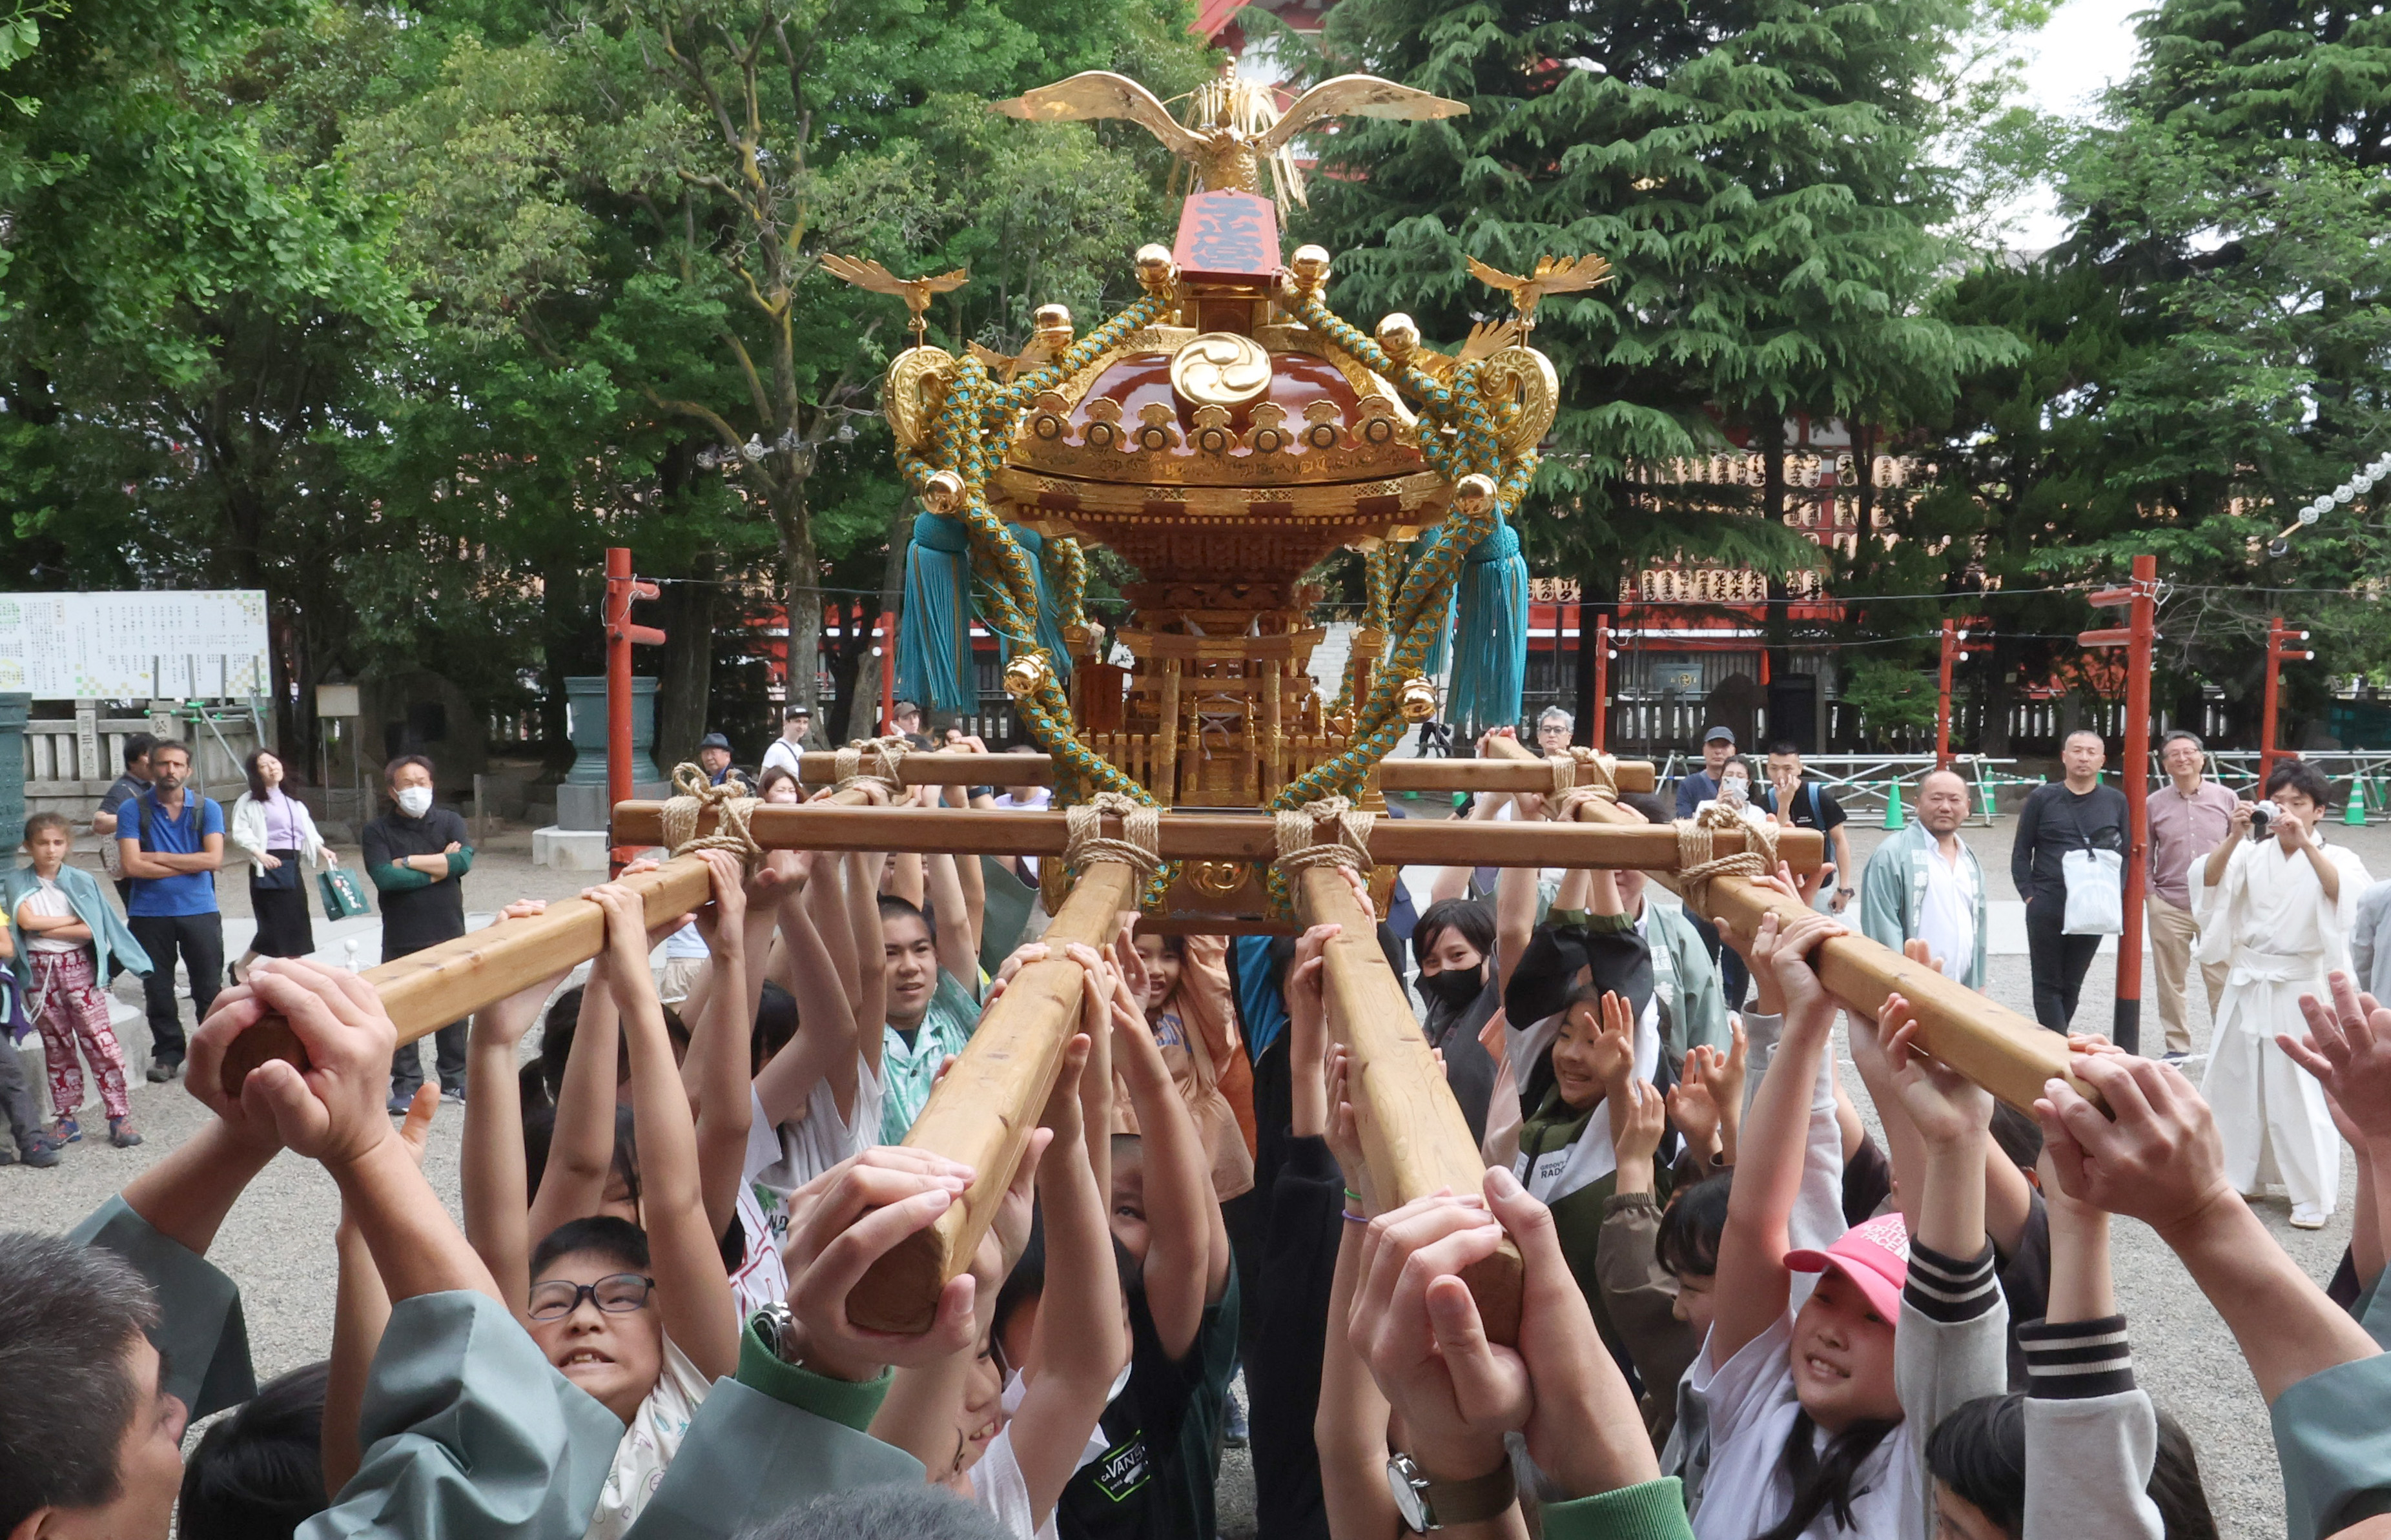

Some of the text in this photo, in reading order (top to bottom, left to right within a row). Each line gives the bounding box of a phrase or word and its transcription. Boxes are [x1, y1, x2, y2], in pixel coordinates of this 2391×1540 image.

[1712, 572, 1727, 599] 花本
[1730, 571, 1743, 599] 花本
[1747, 571, 1763, 599] 花本
[1860, 1224, 1909, 1245] NORTH
[1860, 1232, 1898, 1253] FACE
[1105, 1442, 1143, 1478] VANS
